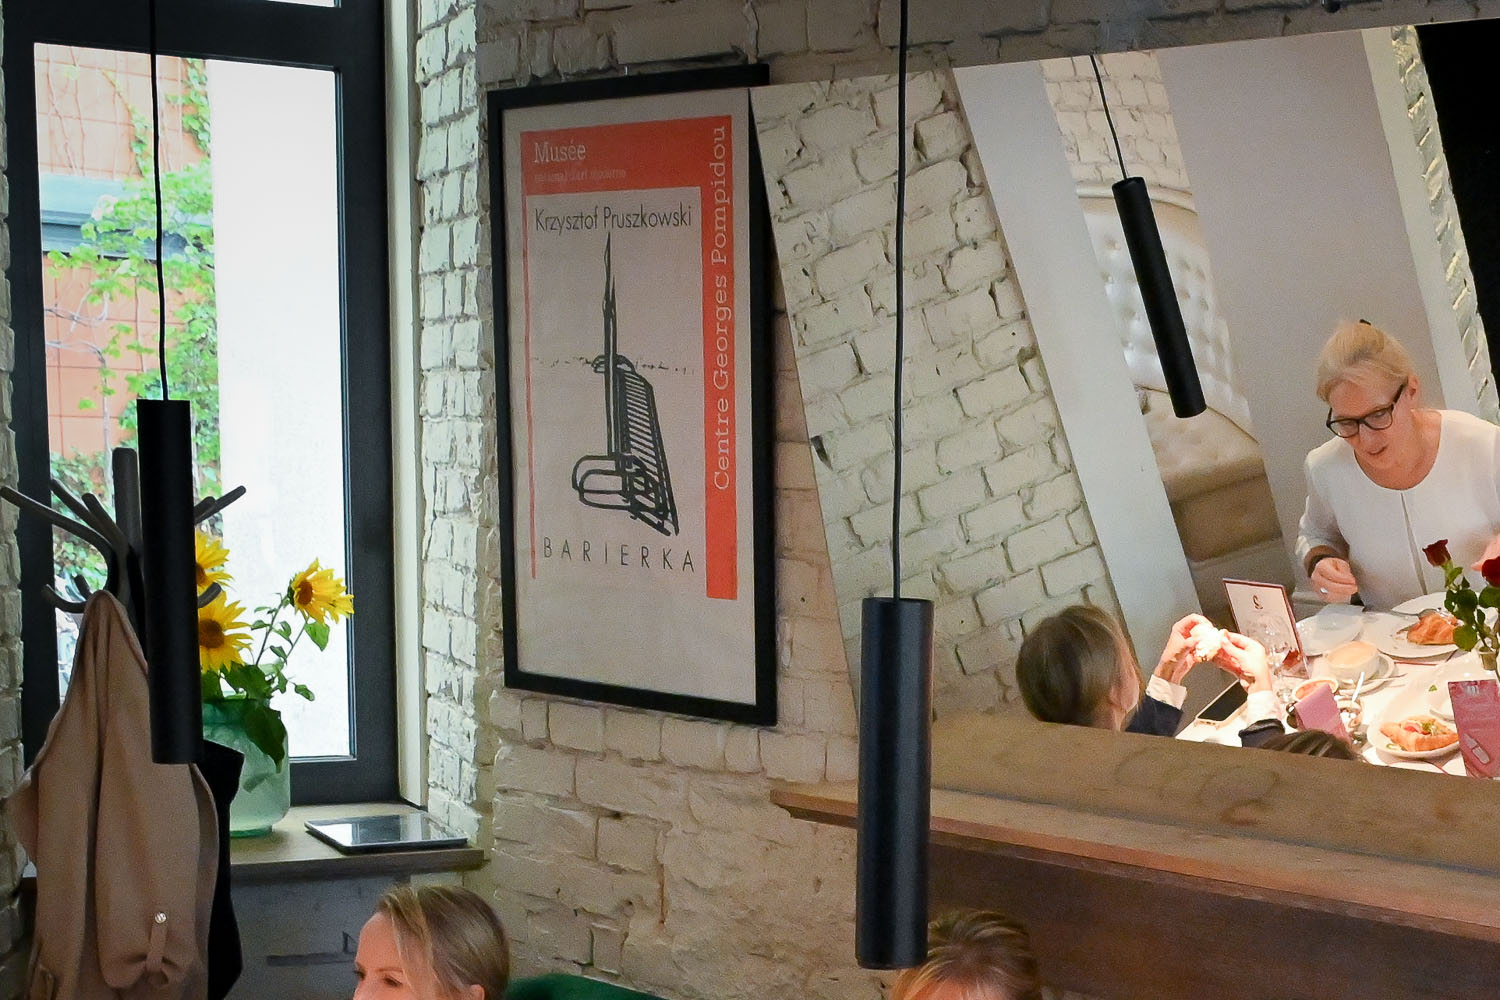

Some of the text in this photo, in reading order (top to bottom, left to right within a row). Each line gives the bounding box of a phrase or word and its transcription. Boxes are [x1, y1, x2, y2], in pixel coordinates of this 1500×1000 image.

[534, 138, 586, 163] Musée
[535, 201, 693, 236] Krzysztof Pruszkowski
[710, 125, 731, 490] Centre Georges Pompidou
[543, 536, 695, 573] BARIERKA
